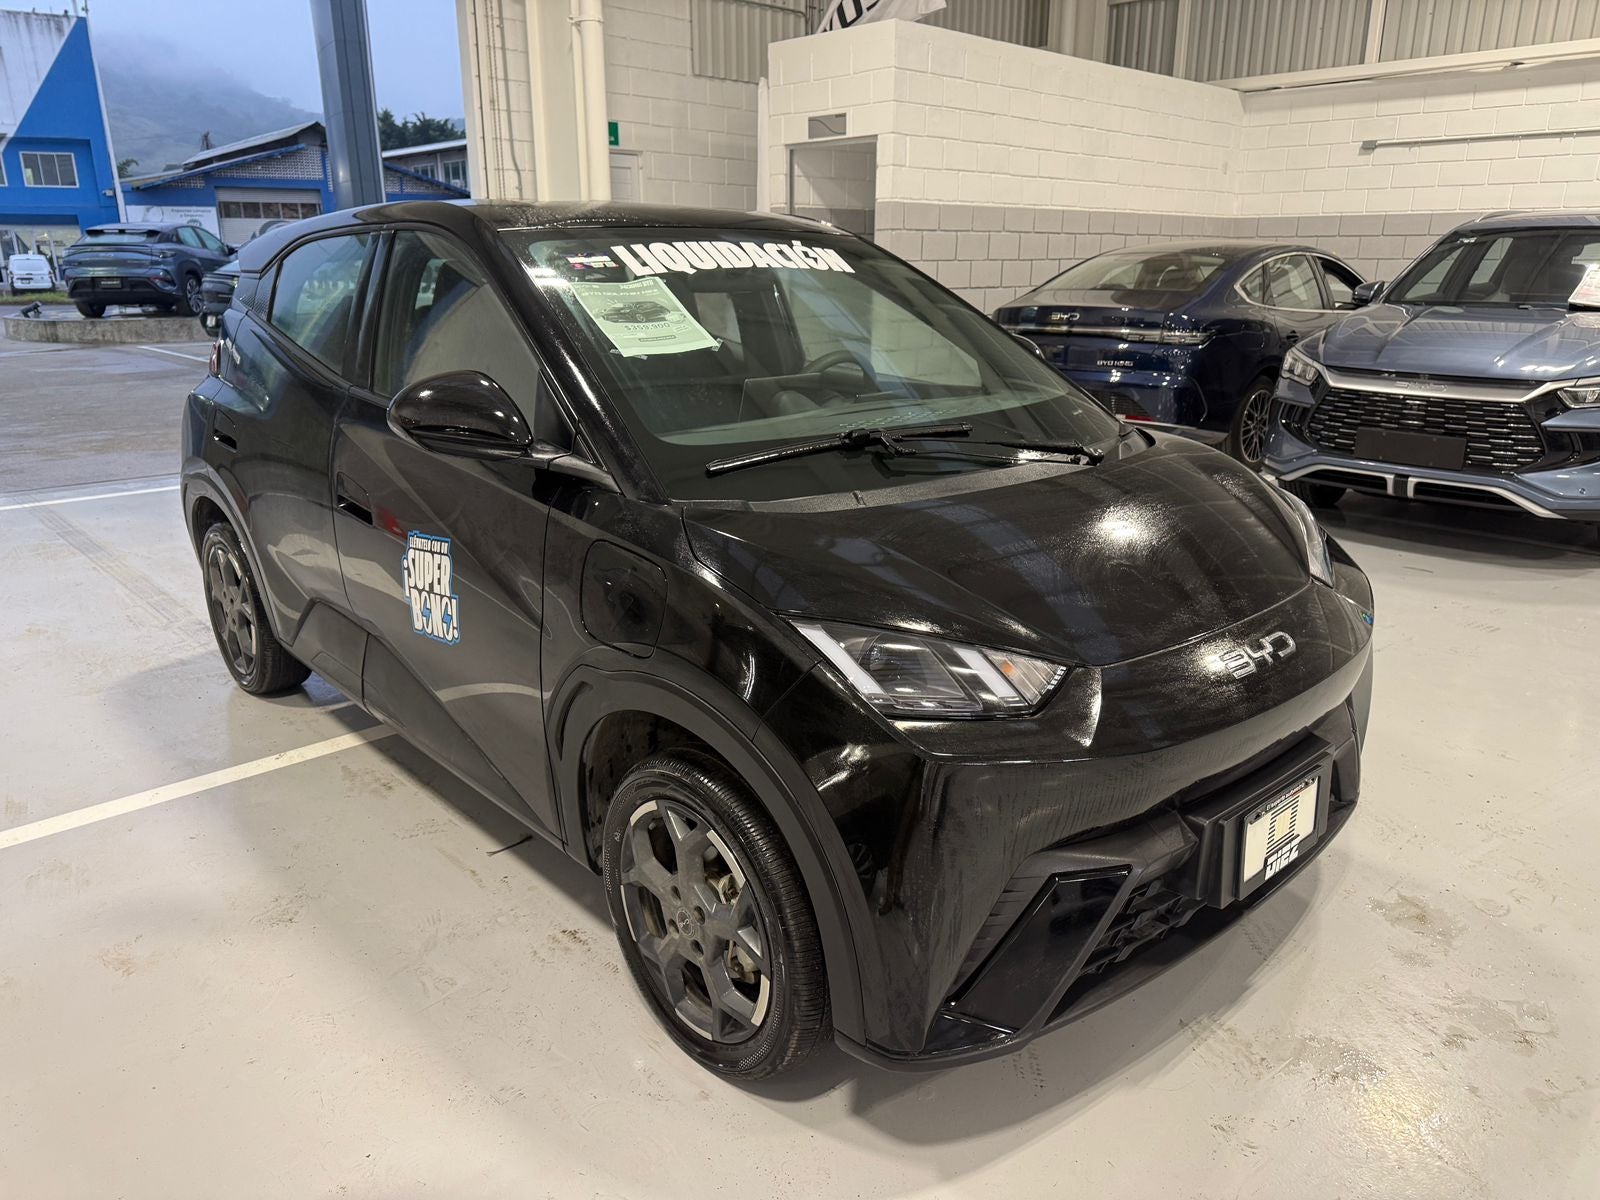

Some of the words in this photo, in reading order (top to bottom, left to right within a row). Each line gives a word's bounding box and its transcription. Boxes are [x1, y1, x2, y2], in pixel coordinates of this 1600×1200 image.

[1051, 312, 1080, 321] BYD
[1218, 631, 1297, 680] BYD
[1264, 834, 1302, 881] DIEZ
